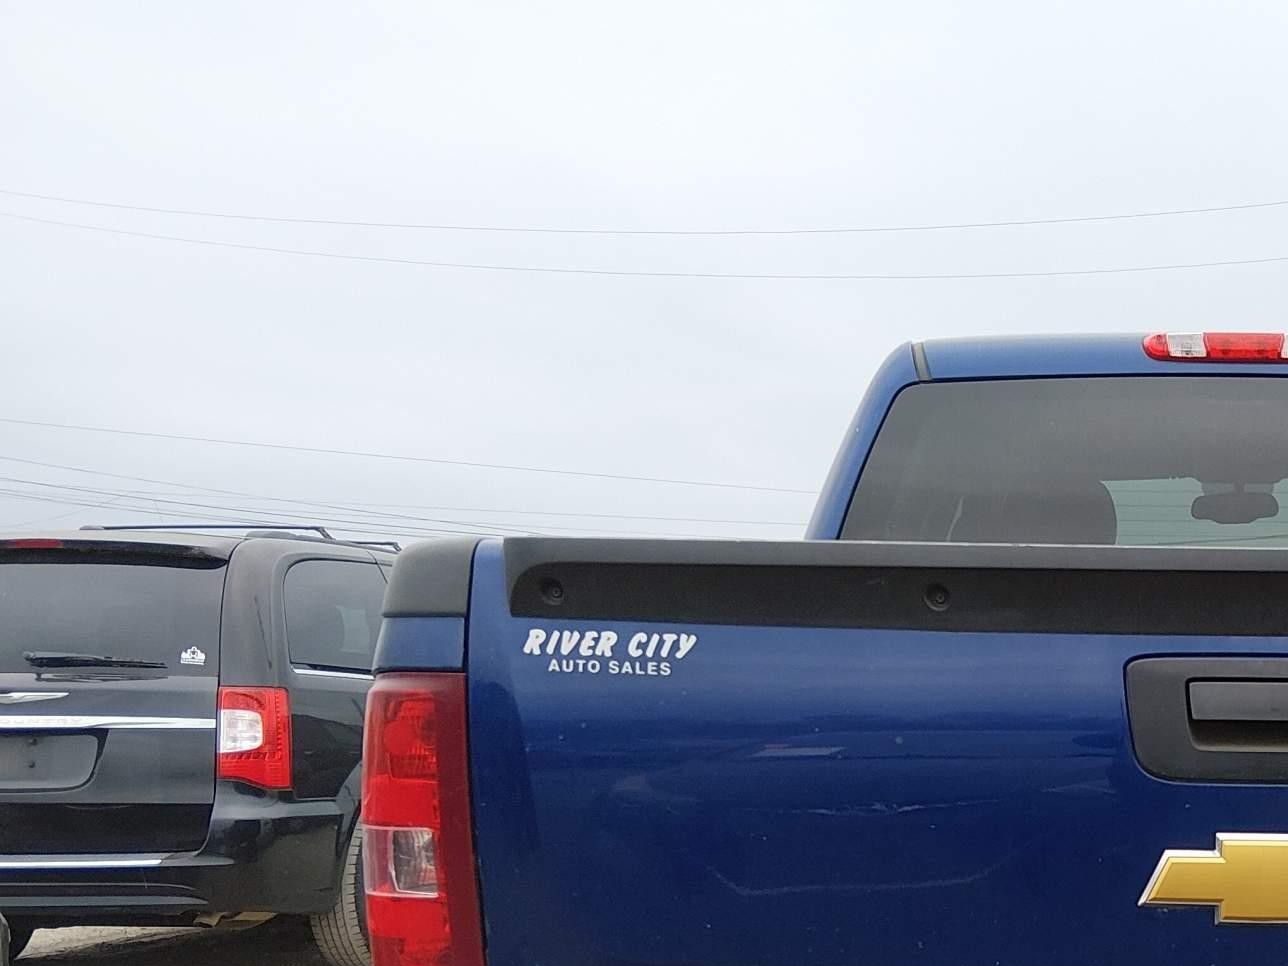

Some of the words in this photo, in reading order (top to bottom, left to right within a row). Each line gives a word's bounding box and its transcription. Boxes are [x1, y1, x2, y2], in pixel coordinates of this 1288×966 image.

[523, 629, 618, 657] RIVER
[628, 632, 697, 659] CITY
[548, 659, 601, 673] AUTO
[608, 661, 672, 676] SALES
